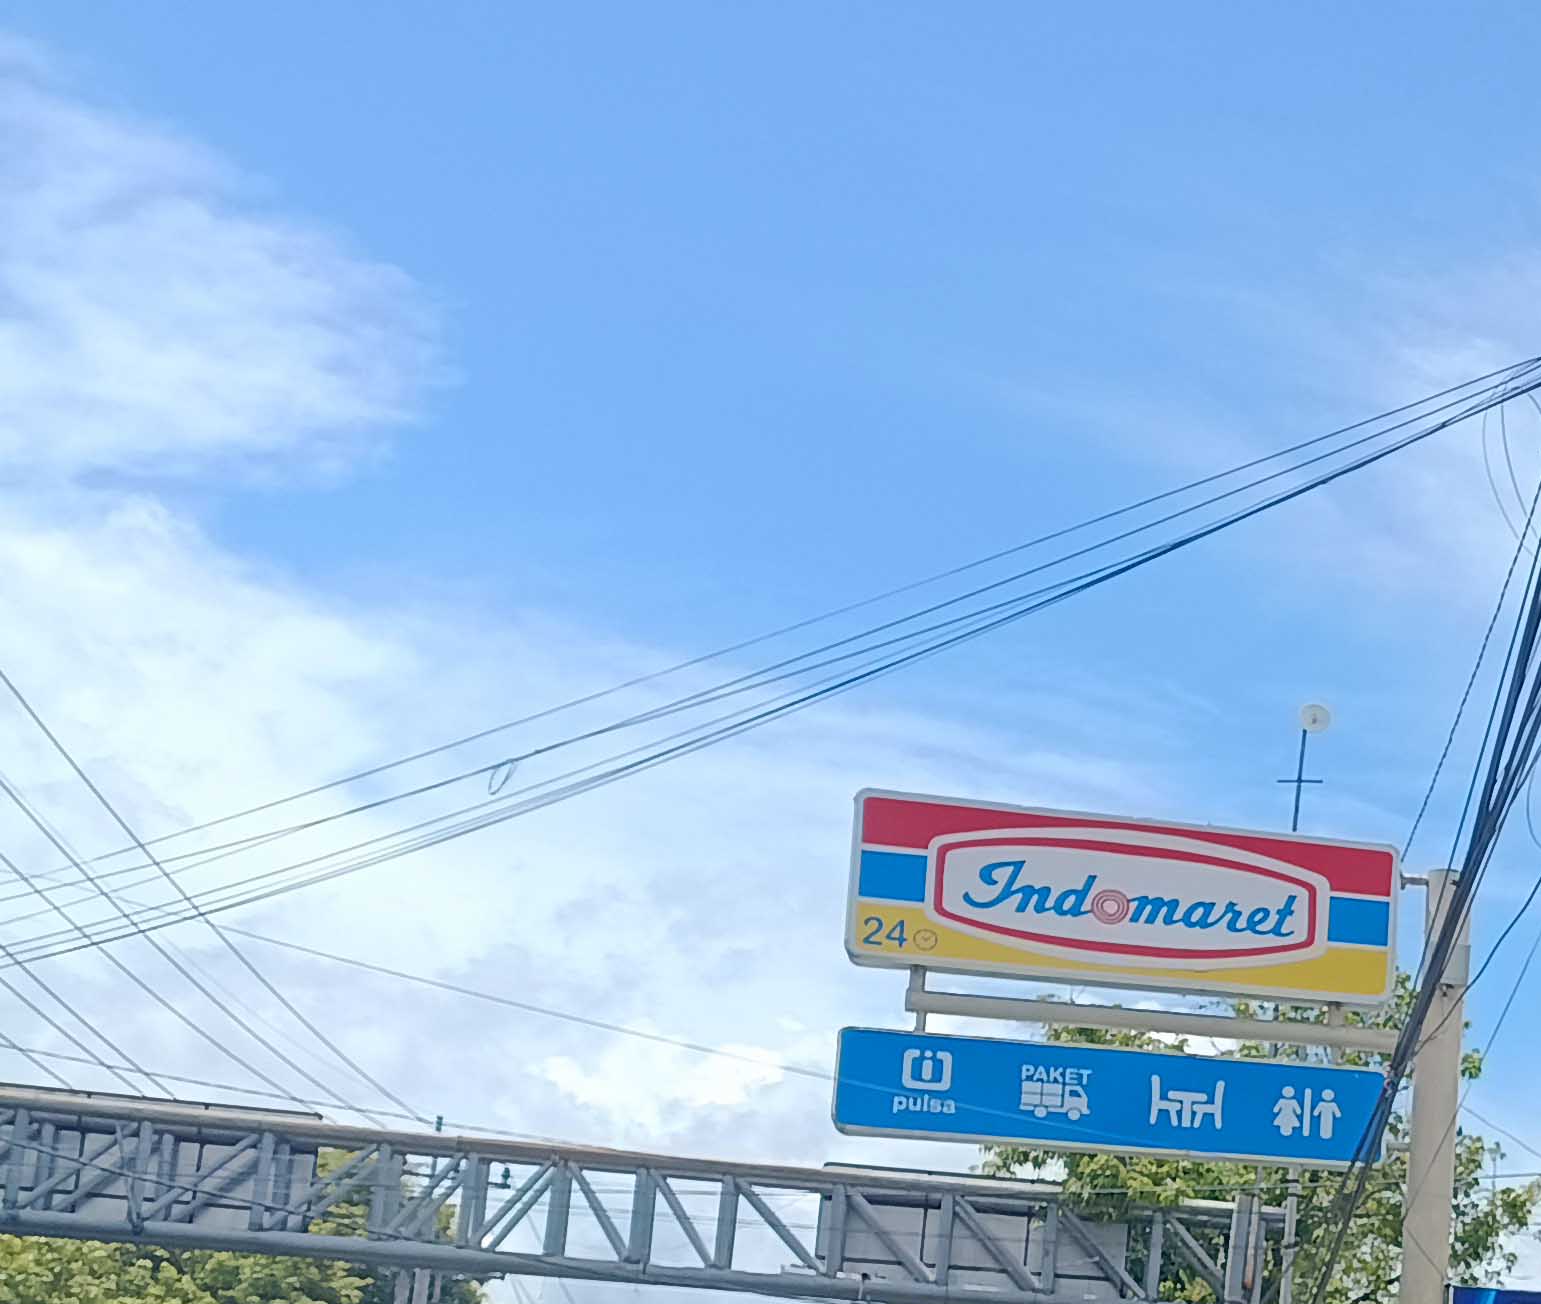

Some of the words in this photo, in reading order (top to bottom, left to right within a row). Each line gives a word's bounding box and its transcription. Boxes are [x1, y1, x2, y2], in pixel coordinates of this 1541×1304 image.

[962, 858, 1297, 938] Indomaret
[861, 917, 907, 948] 24
[1020, 1063, 1092, 1084] PAKET
[892, 1092, 956, 1114] pulsa
